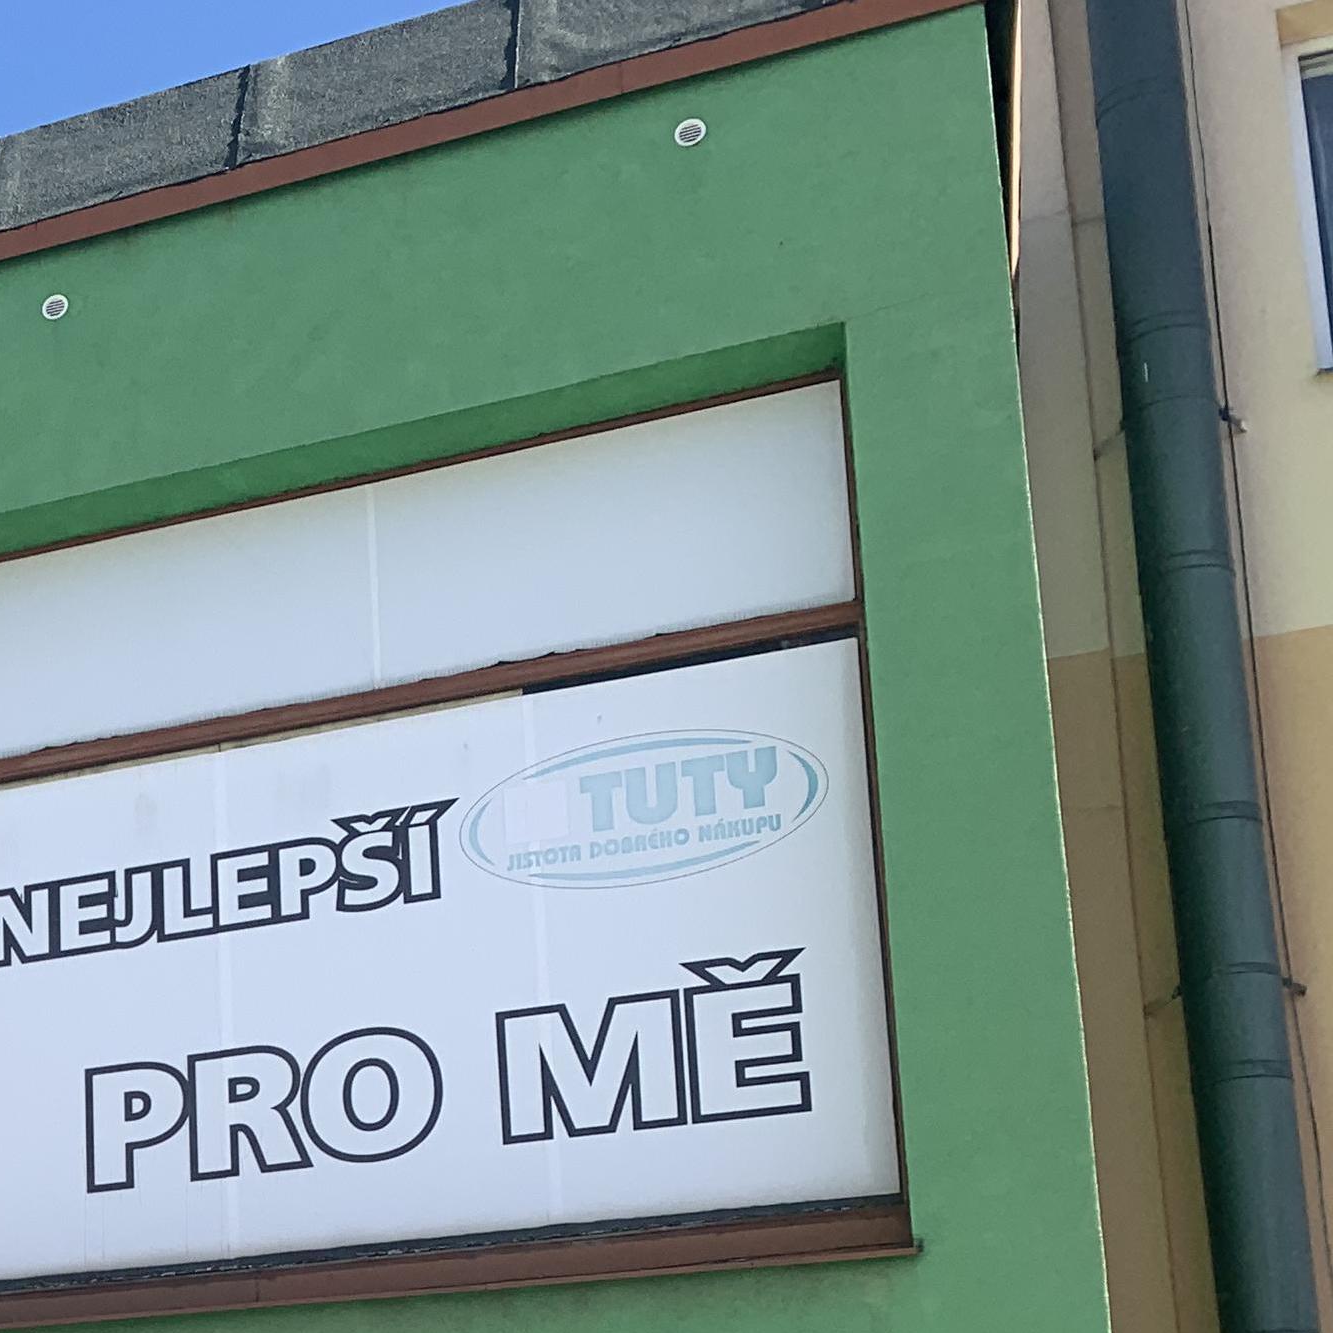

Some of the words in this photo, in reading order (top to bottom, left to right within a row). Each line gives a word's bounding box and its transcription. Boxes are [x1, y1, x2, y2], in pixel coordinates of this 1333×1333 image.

[579, 745, 777, 833] TUTY
[507, 843, 582, 873] JISTOTA
[589, 827, 690, 860] DOBRÉHO
[699, 813, 782, 845] NÁKUPU
[85, 1026, 443, 1193] PRO
[496, 948, 813, 1145] MĚ
